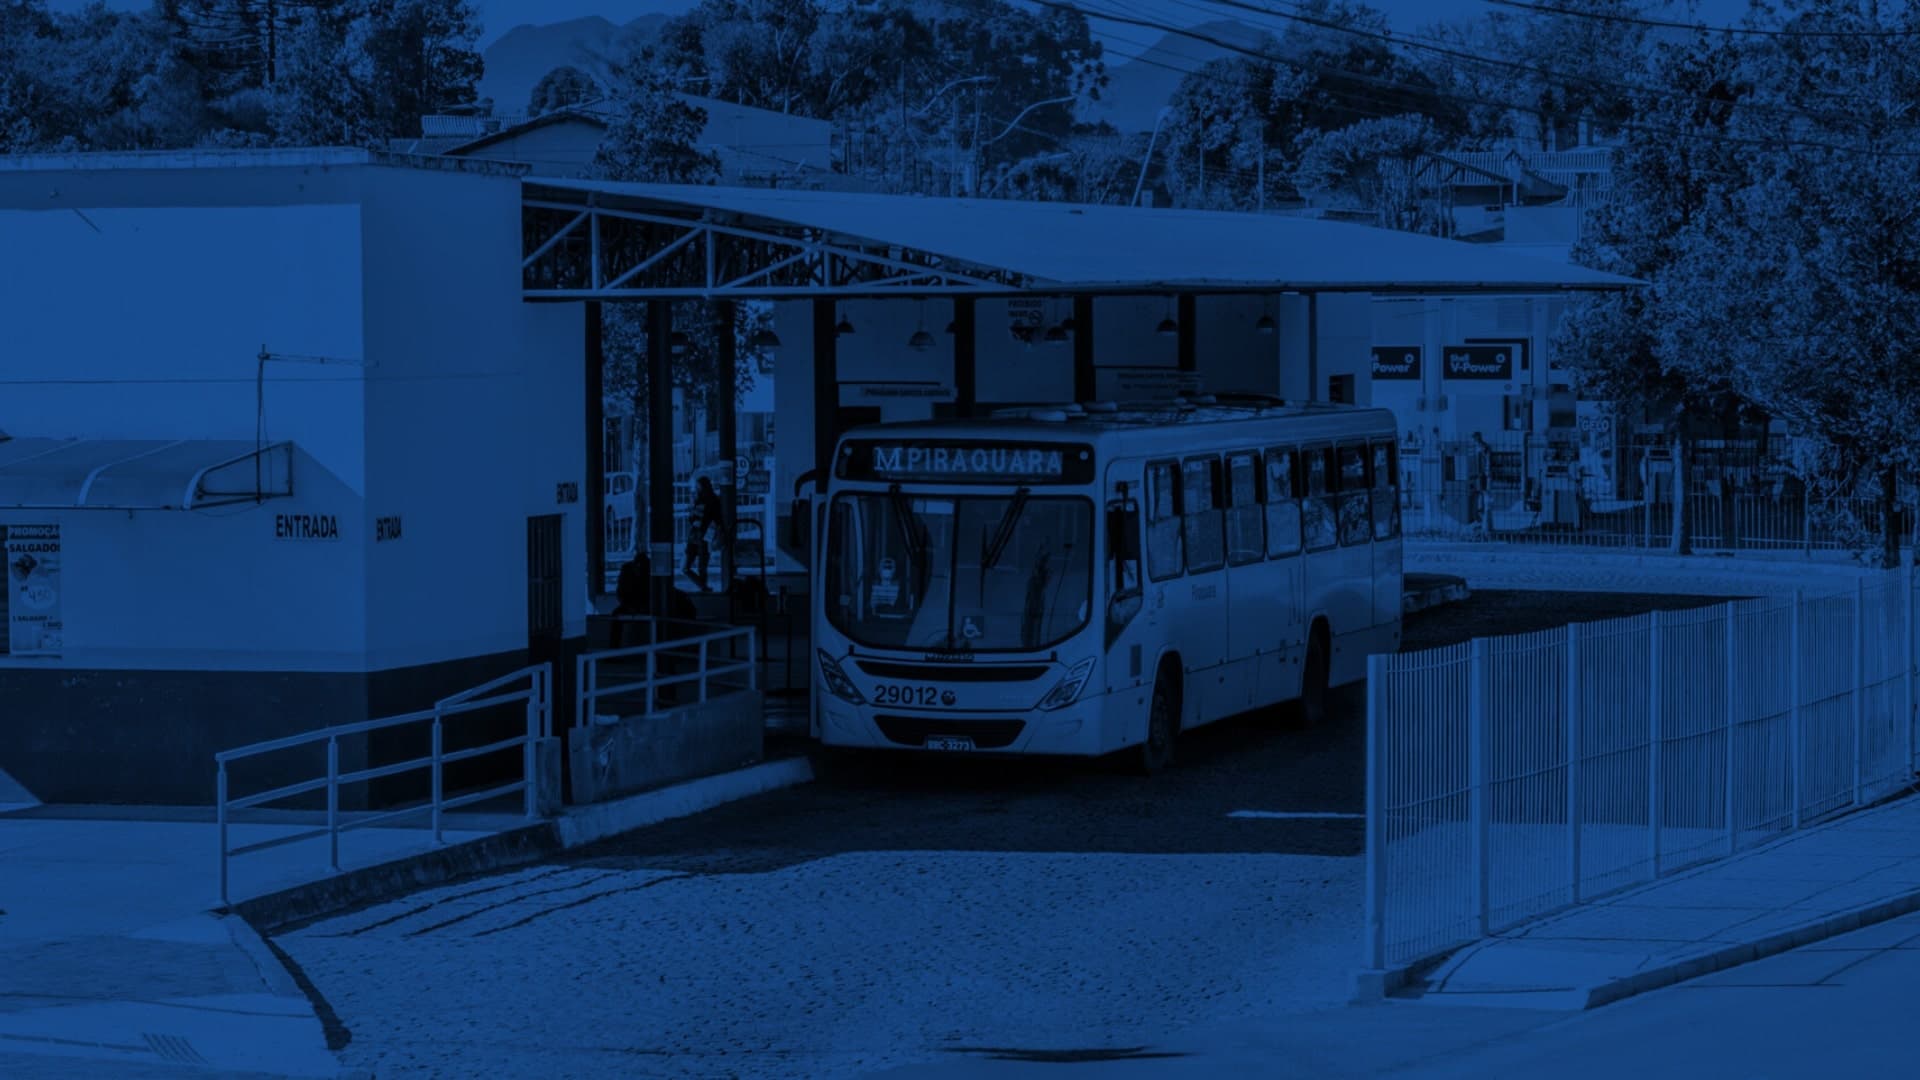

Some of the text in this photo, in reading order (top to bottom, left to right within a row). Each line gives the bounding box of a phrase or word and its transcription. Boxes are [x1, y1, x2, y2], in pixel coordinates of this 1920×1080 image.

[1450, 362, 1502, 372] V-Power
[1582, 418, 1609, 432] GELO
[907, 447, 1063, 474] PIRAQUARA
[276, 514, 338, 538] ENTRADA
[874, 685, 937, 705] 29012
